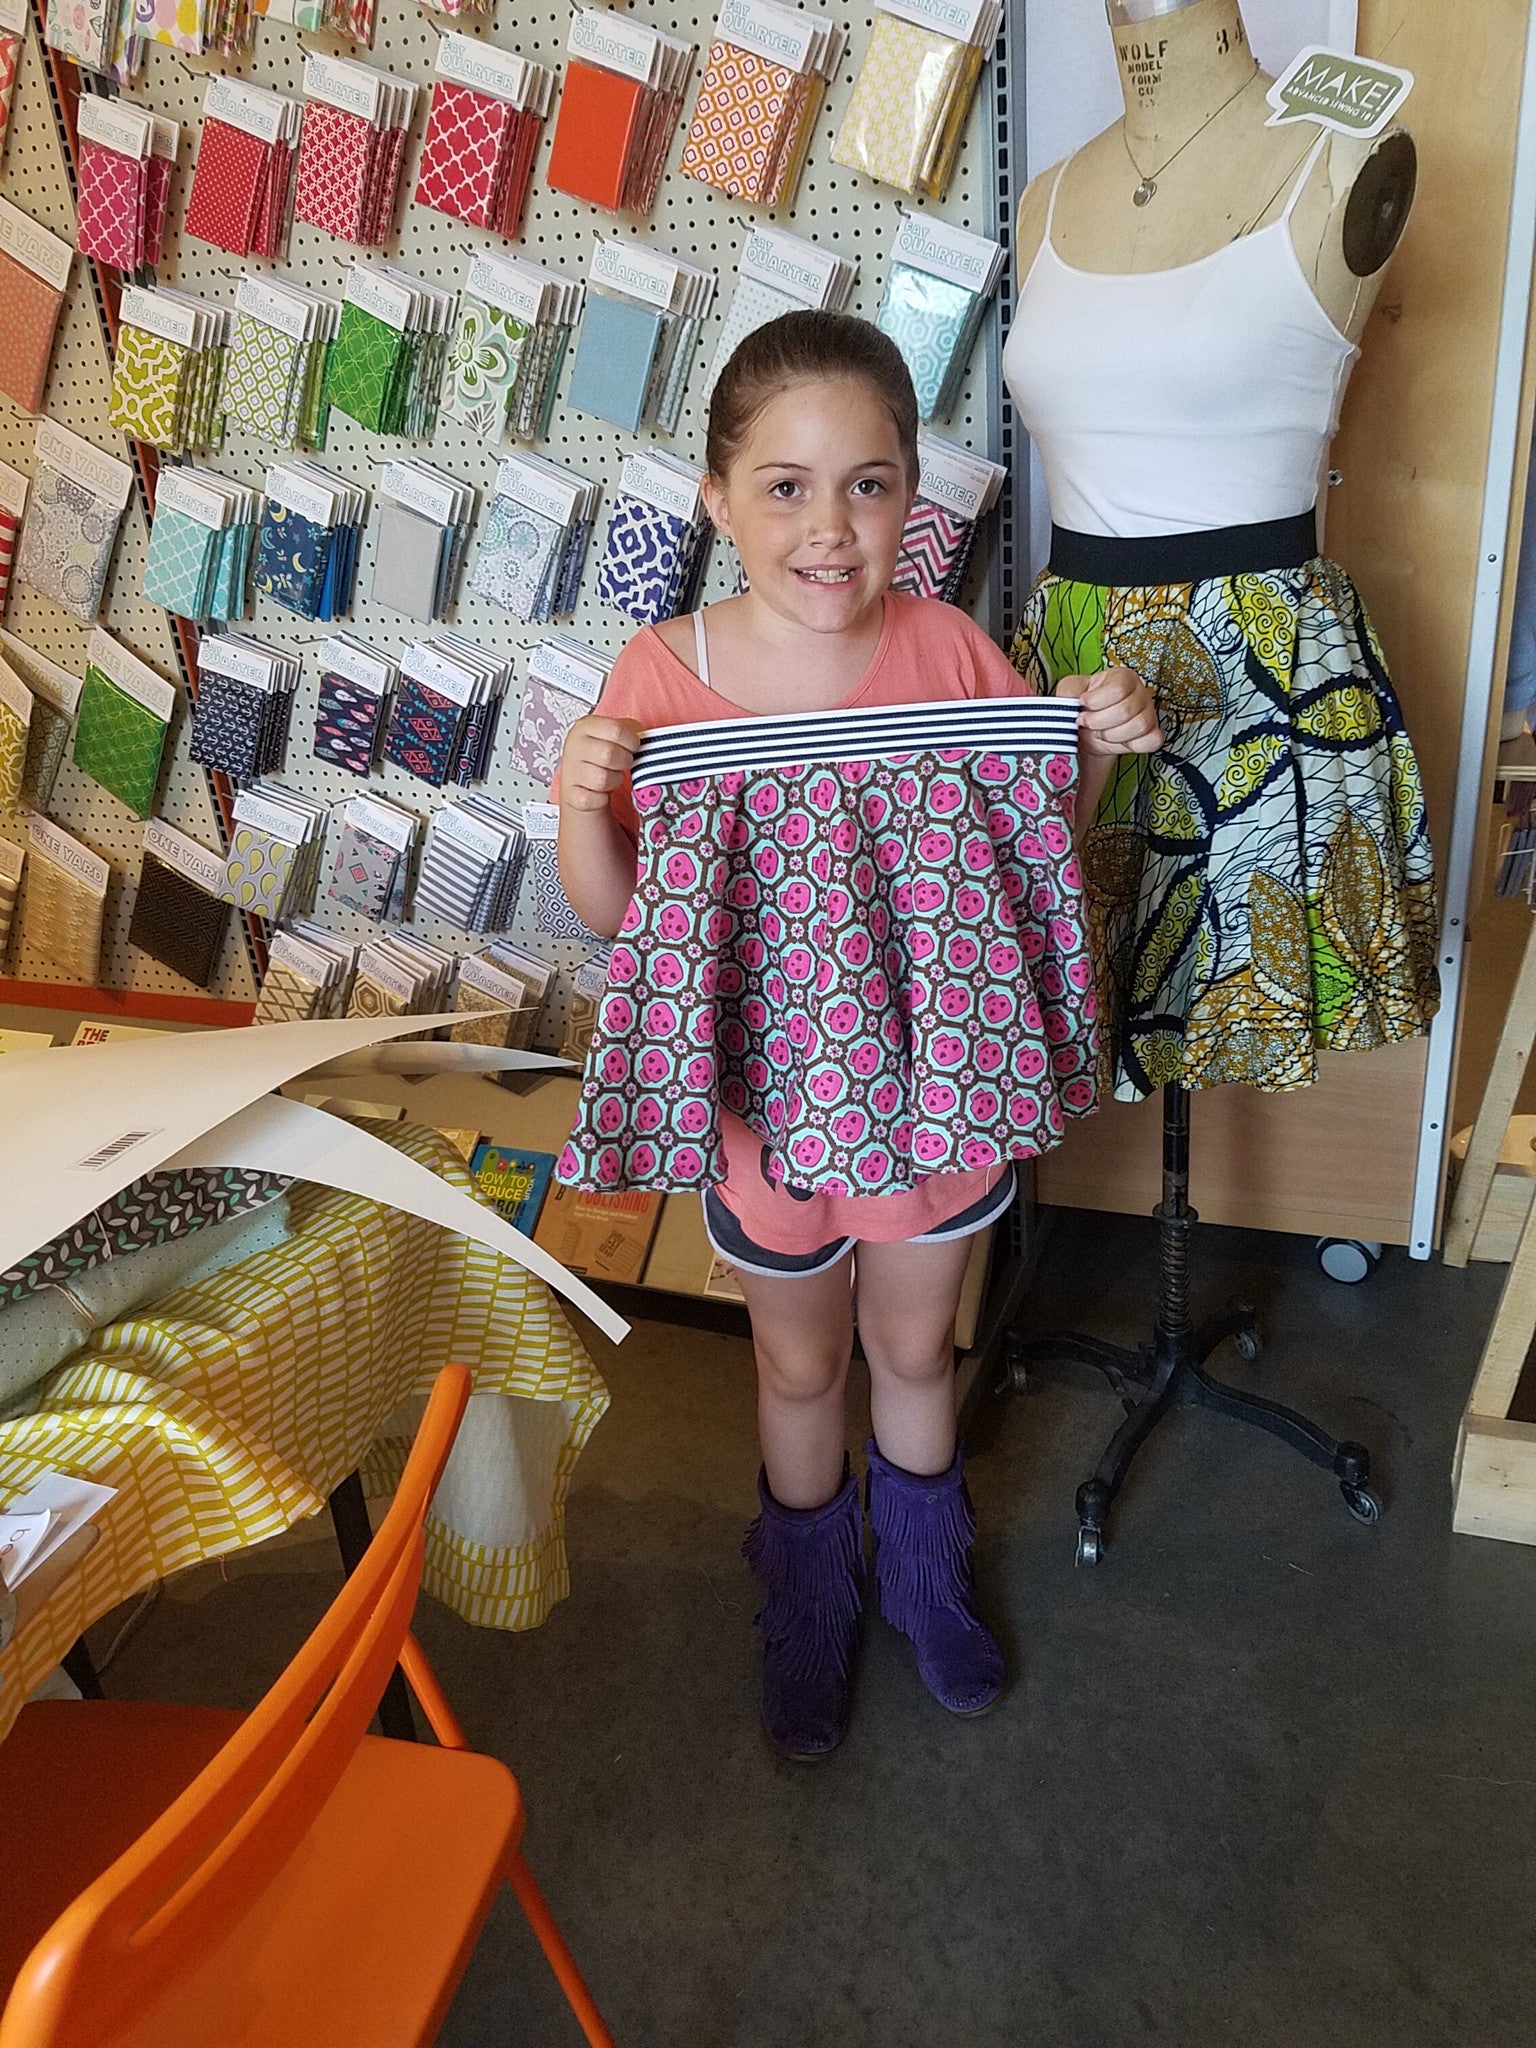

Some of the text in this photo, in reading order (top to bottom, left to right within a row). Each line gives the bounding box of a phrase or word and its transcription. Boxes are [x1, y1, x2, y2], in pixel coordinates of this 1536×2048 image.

[576, 15, 598, 31] FAT
[726, 0, 750, 17] FAT
[444, 41, 466, 56] FAT
[573, 27, 648, 67] QUARTER
[722, 11, 802, 57] QUARTER
[1119, 39, 1168, 61] WOLF
[308, 59, 328, 74] FAT
[441, 52, 514, 90] QUARTER
[1127, 60, 1163, 74] MODEL
[1131, 73, 1162, 86] FORM
[210, 81, 232, 96] FAT
[306, 70, 371, 107] QUARTER
[1286, 85, 1331, 106] ADVANCED
[1330, 100, 1361, 117] SEWING
[1292, 60, 1397, 113] MAKE!
[208, 92, 275, 131] QUARTER
[80, 113, 139, 147] QUARTER
[750, 234, 774, 252] FAT
[904, 221, 930, 238] FAT
[474, 259, 494, 274] FAT
[597, 245, 620, 261] FAT
[746, 247, 822, 290] QUARTER
[900, 234, 984, 275] QUARTER
[470, 269, 535, 309] QUARTER
[594, 258, 669, 296] QUARTER
[125, 290, 145, 304] FAT
[239, 292, 301, 331] QUARTER
[347, 279, 402, 319] QUARTER
[123, 301, 188, 336] QUARTER
[74, 452, 124, 494] YARD
[501, 464, 523, 480] FAT
[626, 459, 647, 474] FAT
[160, 482, 218, 519] QUARTER
[268, 480, 325, 517] QUARTER
[385, 475, 446, 512] QUARTER
[499, 473, 565, 515] QUARTER
[624, 470, 690, 510] QUARTER
[920, 472, 978, 507] ARTER
[201, 650, 265, 680] QUARTER
[321, 650, 381, 684] QUARTER
[406, 655, 467, 696] QUARTER
[533, 656, 597, 694] QUARTER
[237, 804, 300, 835] QUARTER
[439, 815, 496, 856] QUARTER
[32, 824, 104, 884] ONE YARD
[147, 827, 180, 859] ONE
[273, 942, 322, 978] QUARTER
[360, 957, 409, 998] QUARTER
[462, 966, 518, 1000] QUARTER
[83, 1027, 110, 1043] THE
[475, 1170, 528, 1189] HOW TO
[480, 1184, 523, 1201] EDUCE
